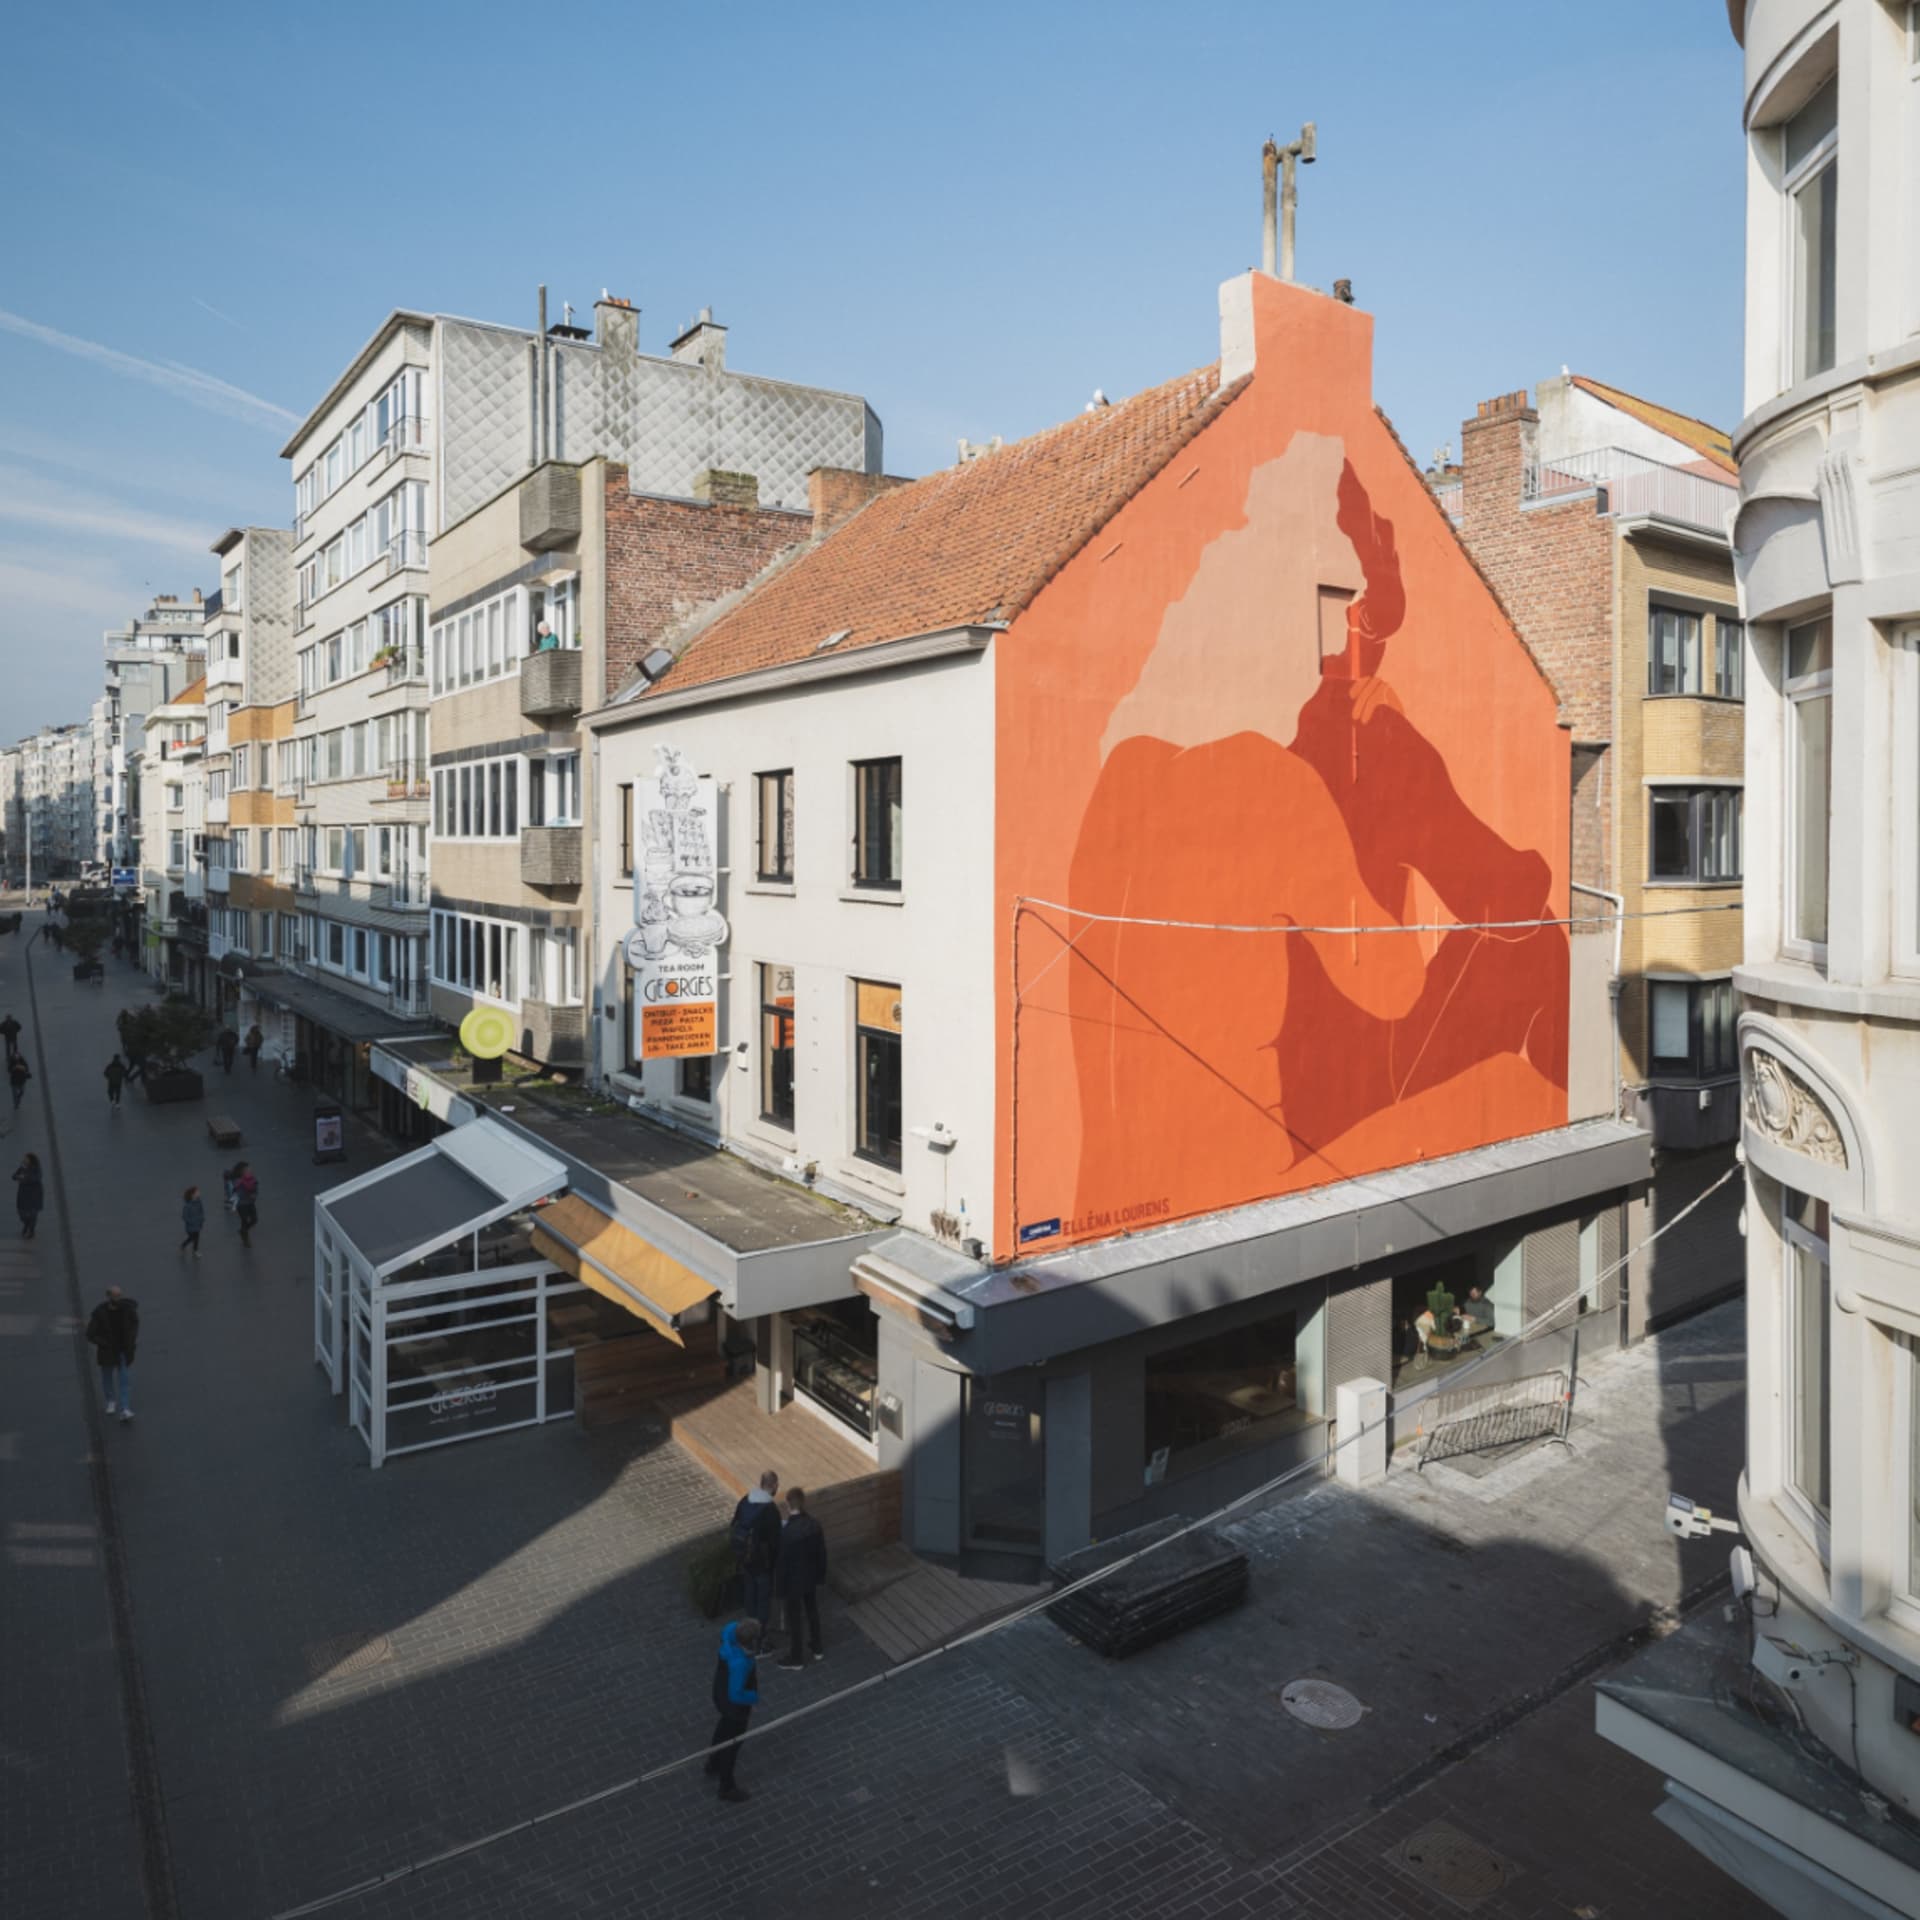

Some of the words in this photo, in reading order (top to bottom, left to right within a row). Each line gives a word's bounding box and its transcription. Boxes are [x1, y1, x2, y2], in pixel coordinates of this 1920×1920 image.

[658, 964, 675, 972] TEA
[677, 963, 705, 972] ROOM
[644, 976, 713, 1003] GEORGES
[1114, 1198, 1170, 1224] LOURENS
